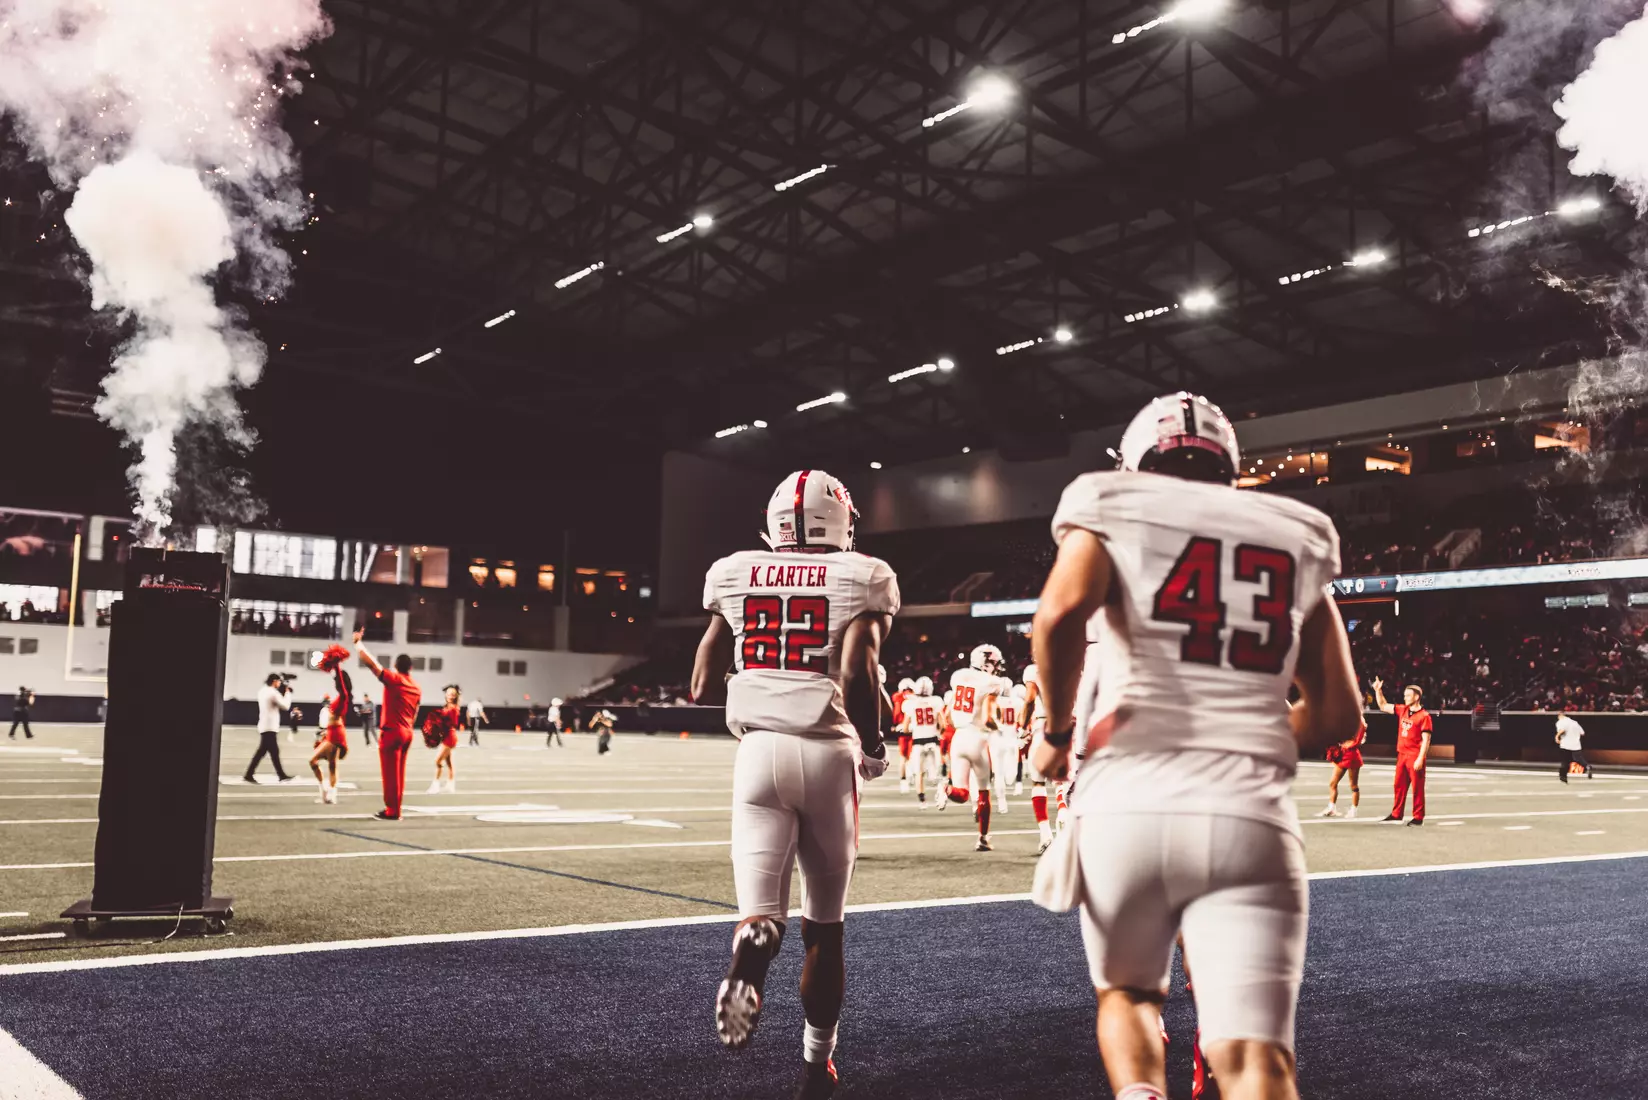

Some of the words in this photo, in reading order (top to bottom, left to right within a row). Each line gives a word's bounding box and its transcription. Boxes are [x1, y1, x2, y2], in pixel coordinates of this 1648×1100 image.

[1152, 536, 1296, 675] 43
[743, 595, 830, 674] 82
[915, 707, 934, 726] 86
[953, 685, 976, 714] 89
